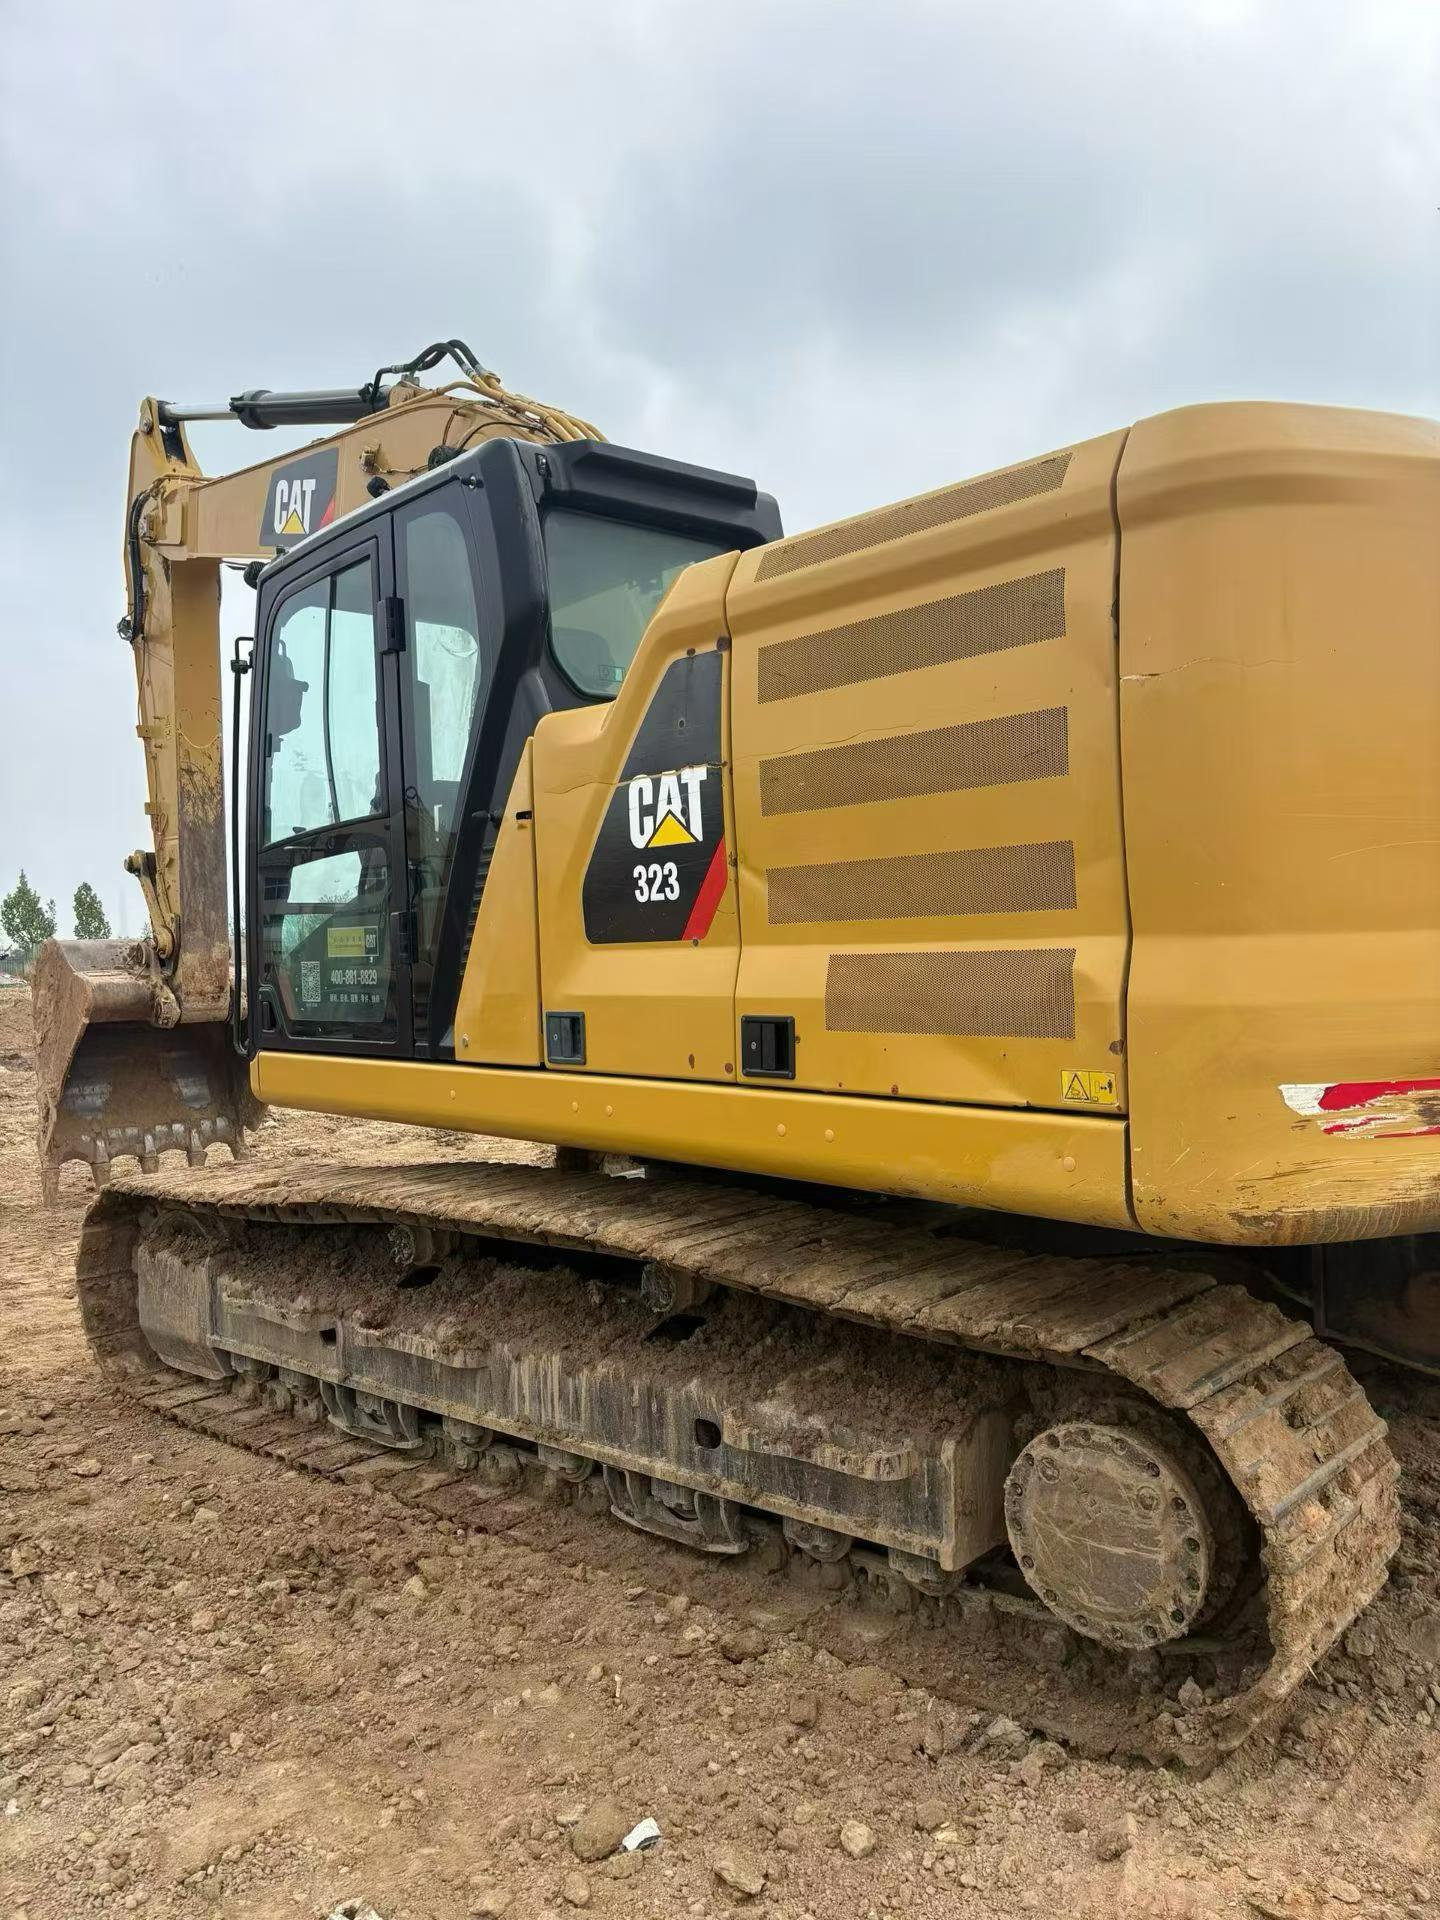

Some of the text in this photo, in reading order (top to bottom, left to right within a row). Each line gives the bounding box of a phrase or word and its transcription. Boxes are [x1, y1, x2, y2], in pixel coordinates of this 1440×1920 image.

[274, 479, 317, 534] CAT
[628, 766, 708, 849] CAT
[633, 862, 680, 903] 323
[330, 969, 378, 985] 400-881-8829
